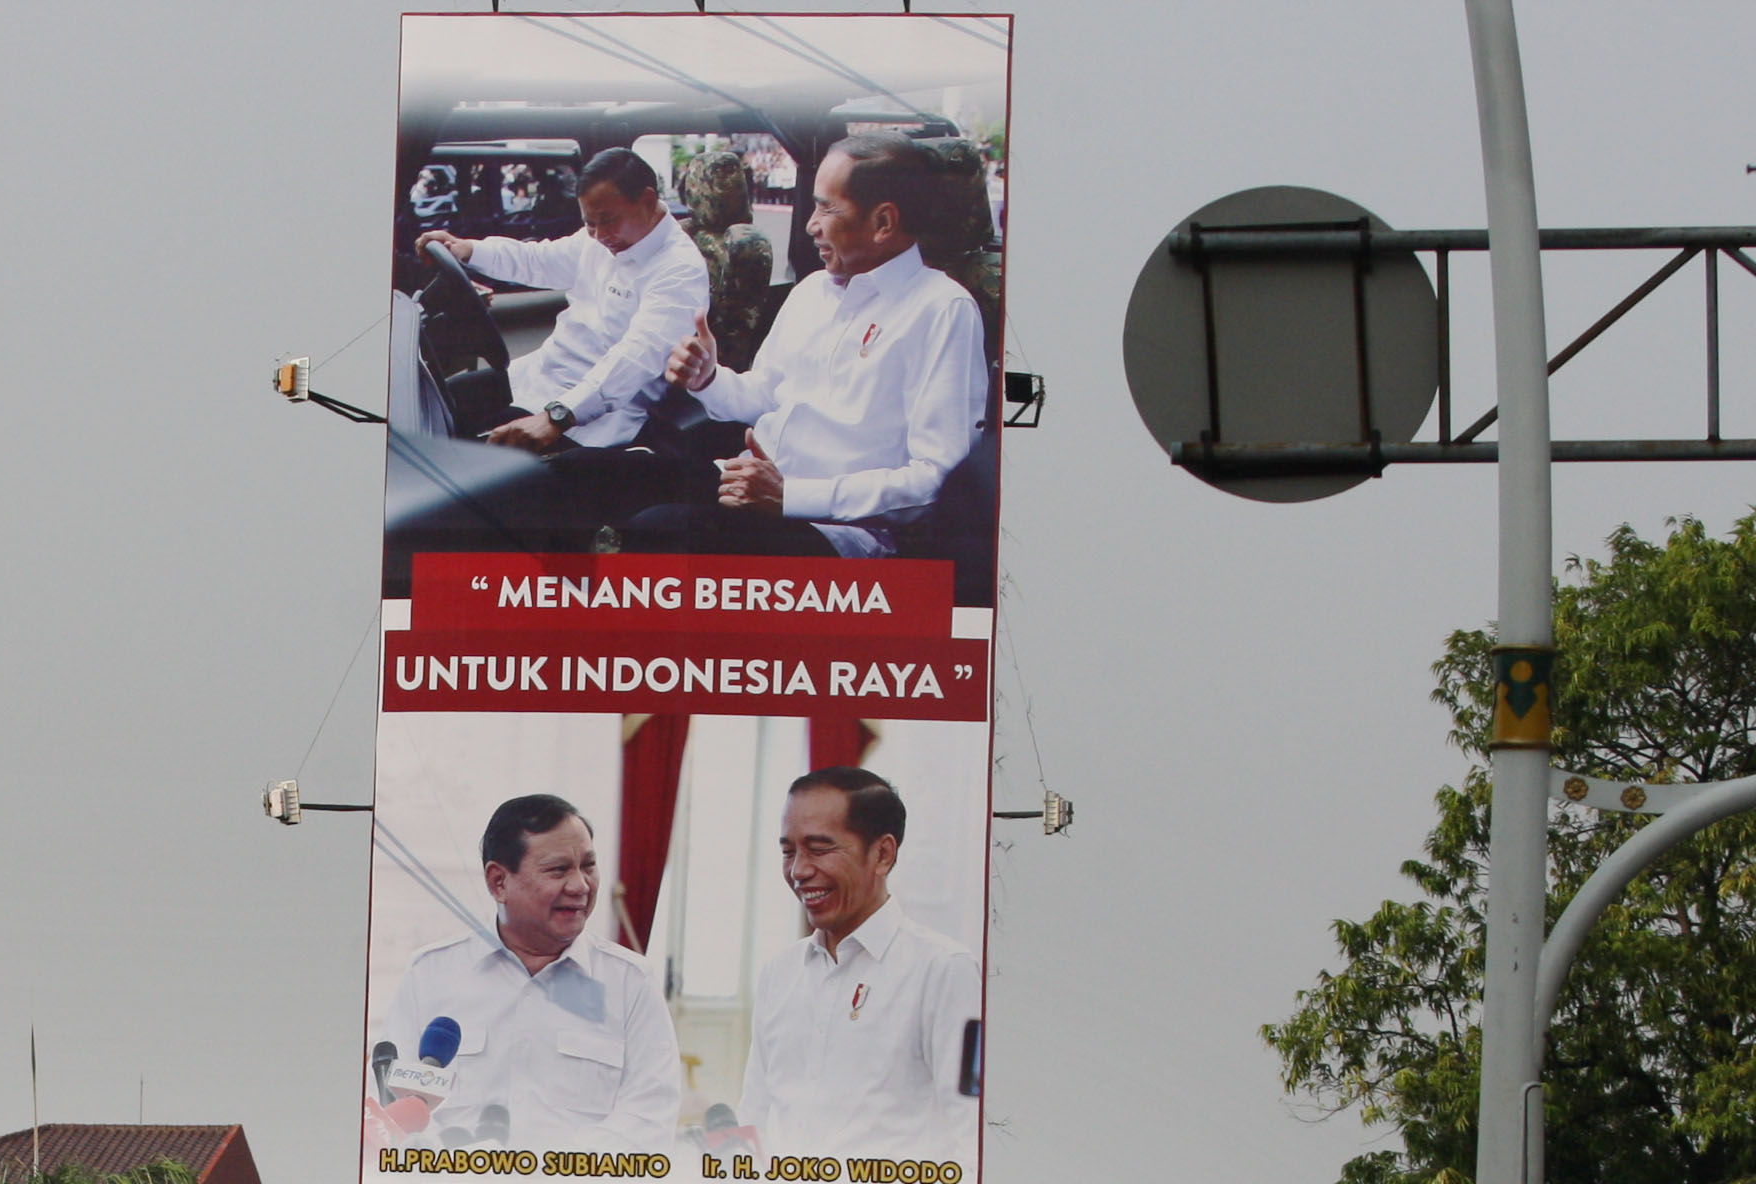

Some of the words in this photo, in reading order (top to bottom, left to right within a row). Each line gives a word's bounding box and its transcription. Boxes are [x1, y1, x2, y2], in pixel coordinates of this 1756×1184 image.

[497, 575, 682, 610] MENANG
[694, 577, 892, 614] BERSAMA
[395, 655, 549, 692] UNTUK
[561, 656, 818, 696] INDONESIA
[829, 661, 945, 699] RAYA
[379, 1148, 538, 1175] H.PRABOWO
[542, 1151, 671, 1178] SUBIANTO
[702, 1153, 727, 1179] Ir.
[733, 1154, 760, 1180] H.
[765, 1156, 841, 1182] JOKO
